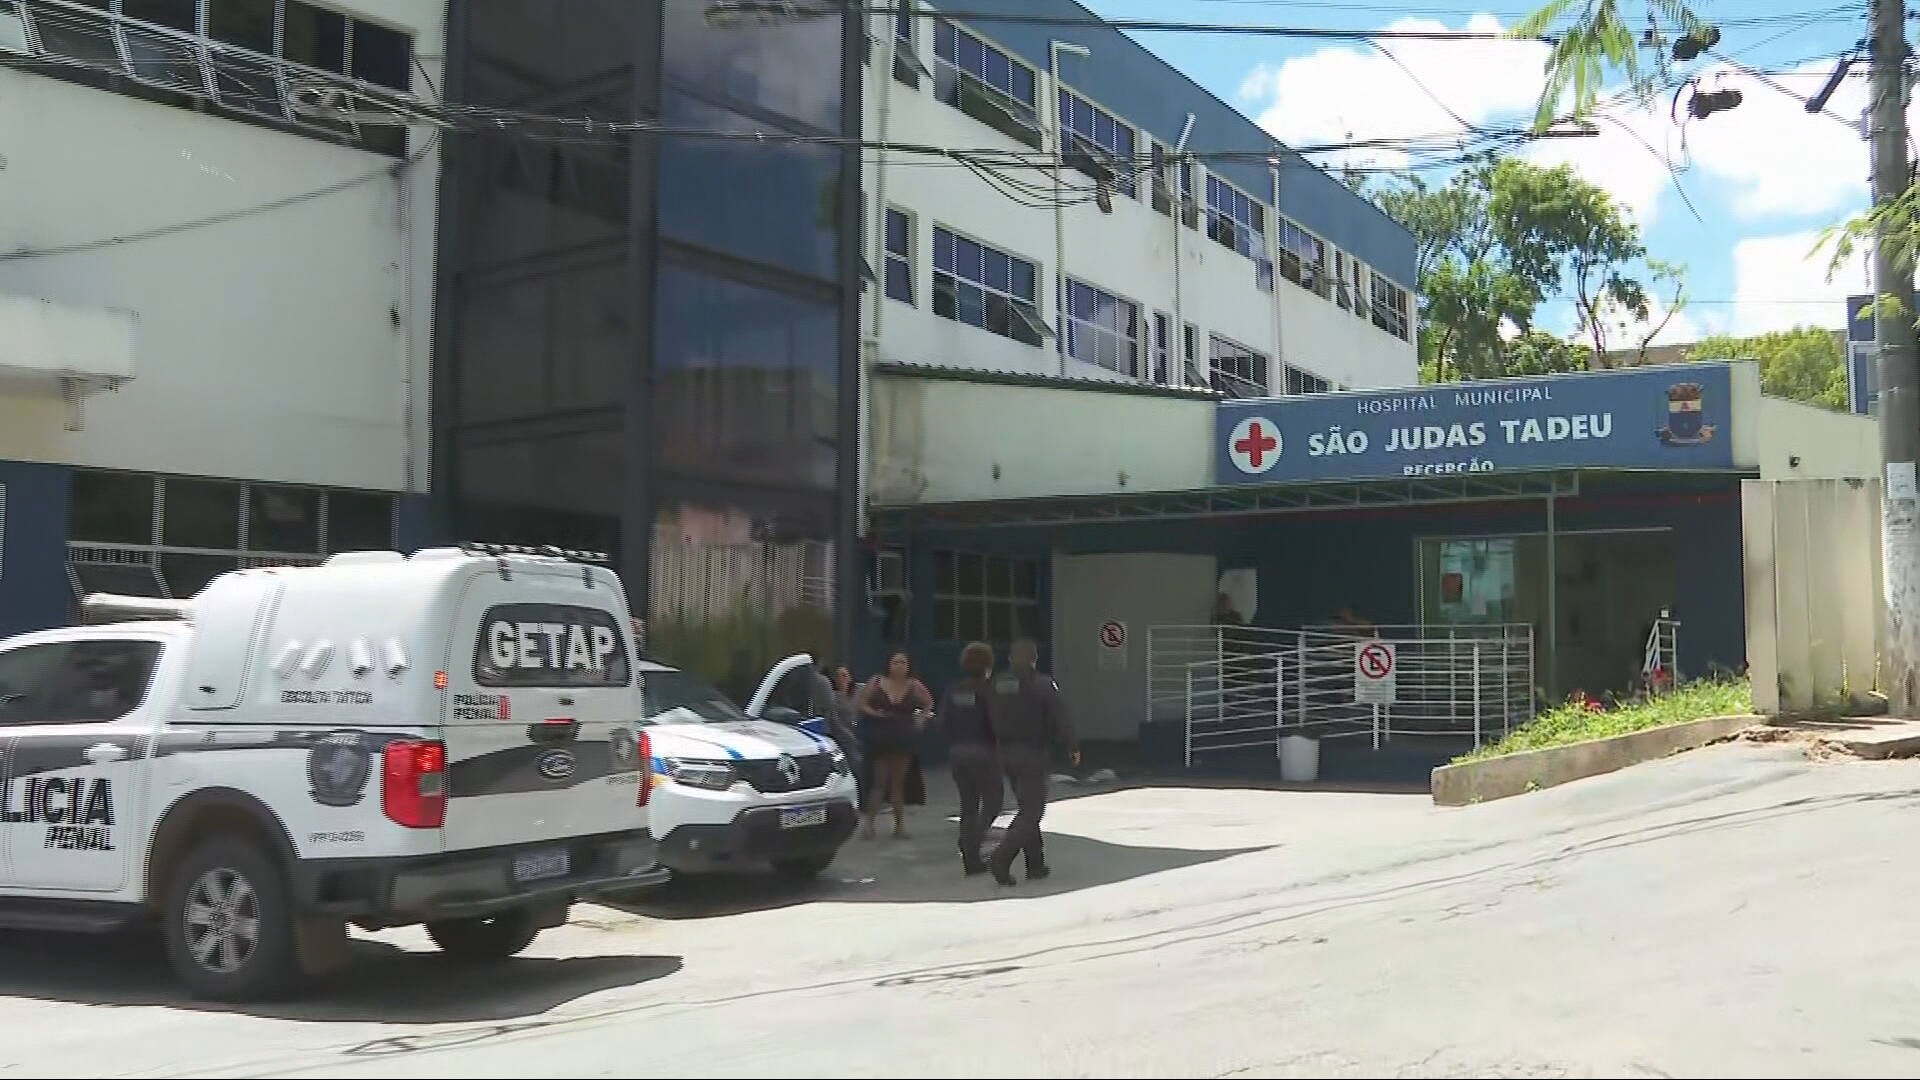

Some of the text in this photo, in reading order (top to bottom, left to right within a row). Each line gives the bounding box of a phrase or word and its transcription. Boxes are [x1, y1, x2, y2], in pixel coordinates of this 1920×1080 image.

[1356, 386, 1553, 415] HOSPITAL MUNICIPAL
[1307, 412, 1614, 456] SÃO JUDAS TADEU
[487, 621, 616, 671] GETAP
[281, 690, 332, 704] ESCOLTA
[454, 707, 499, 720] PENAL
[45, 826, 116, 851] PENAL
